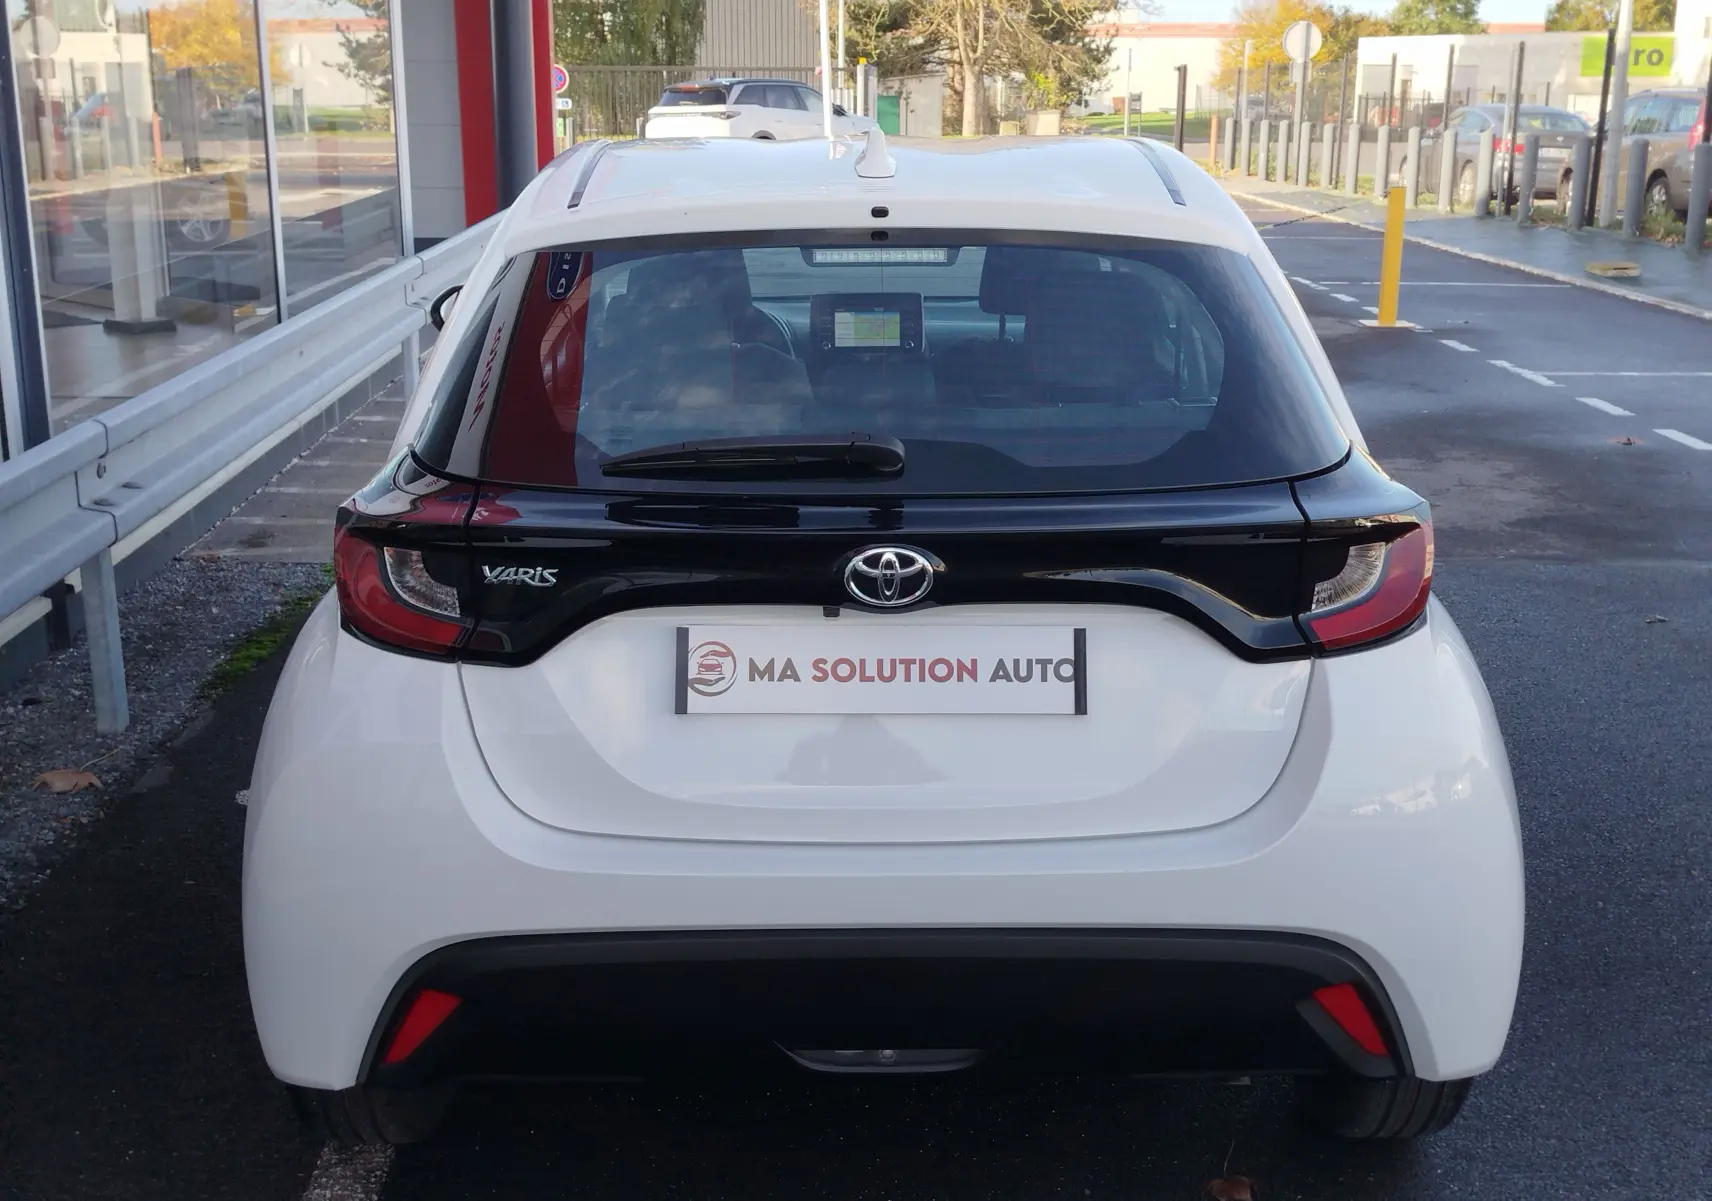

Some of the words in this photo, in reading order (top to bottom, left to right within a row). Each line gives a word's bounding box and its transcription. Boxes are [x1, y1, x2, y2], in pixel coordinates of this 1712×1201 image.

[1614, 46, 1664, 66] ro
[748, 657, 802, 682] MA
[811, 657, 978, 683] SOLUTION
[988, 657, 1076, 683] AUTO
